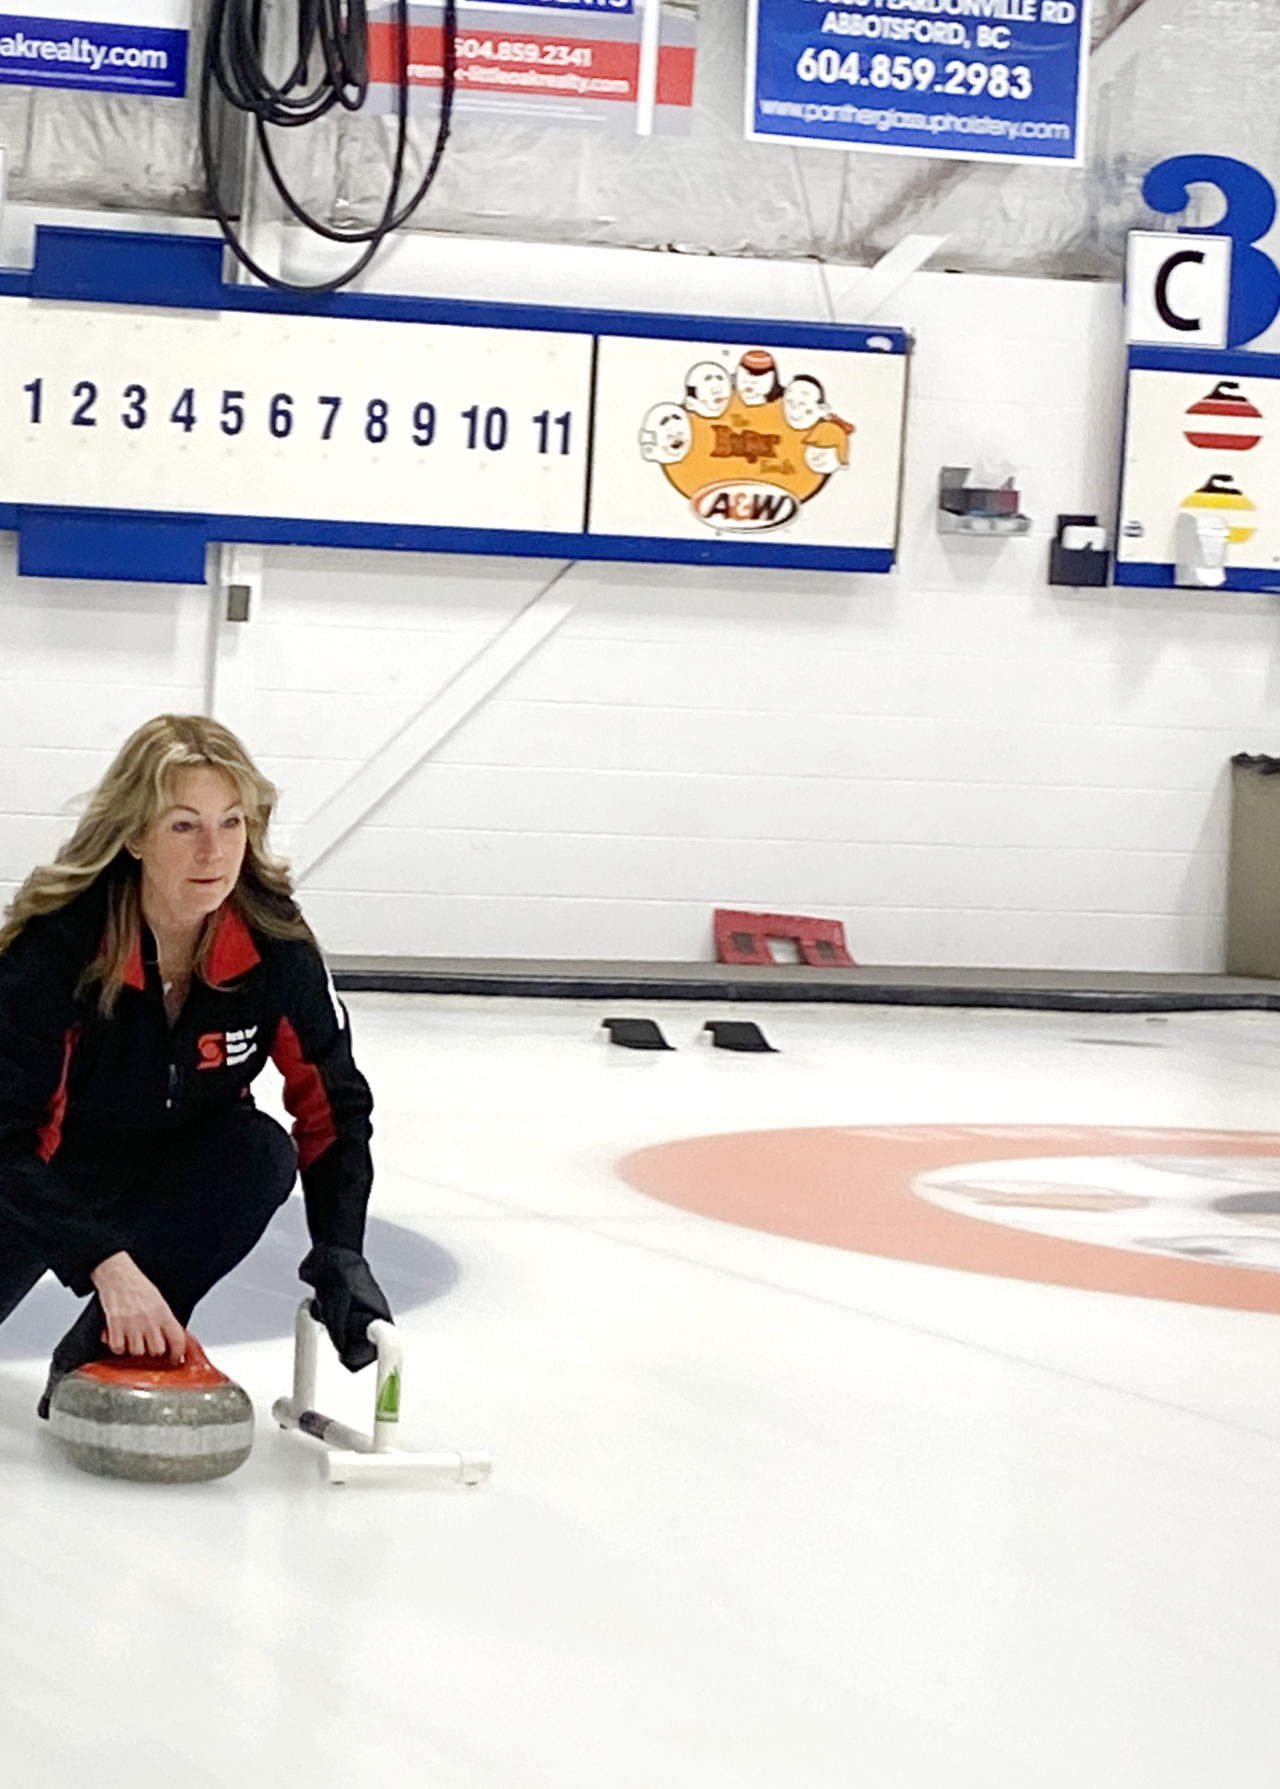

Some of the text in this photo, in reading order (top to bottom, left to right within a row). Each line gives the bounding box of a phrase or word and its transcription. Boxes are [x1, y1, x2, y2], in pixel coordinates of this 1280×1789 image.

[821, 11, 1012, 49] ABBOTSFORD, BC
[1040, 1, 1076, 24] RD
[796, 48, 1033, 100] 604.859.2983
[1155, 250, 1206, 331] C
[23, 378, 571, 455] 1 2 3 4 5 6 7 8 9 10 11
[704, 492, 787, 521] A&W
